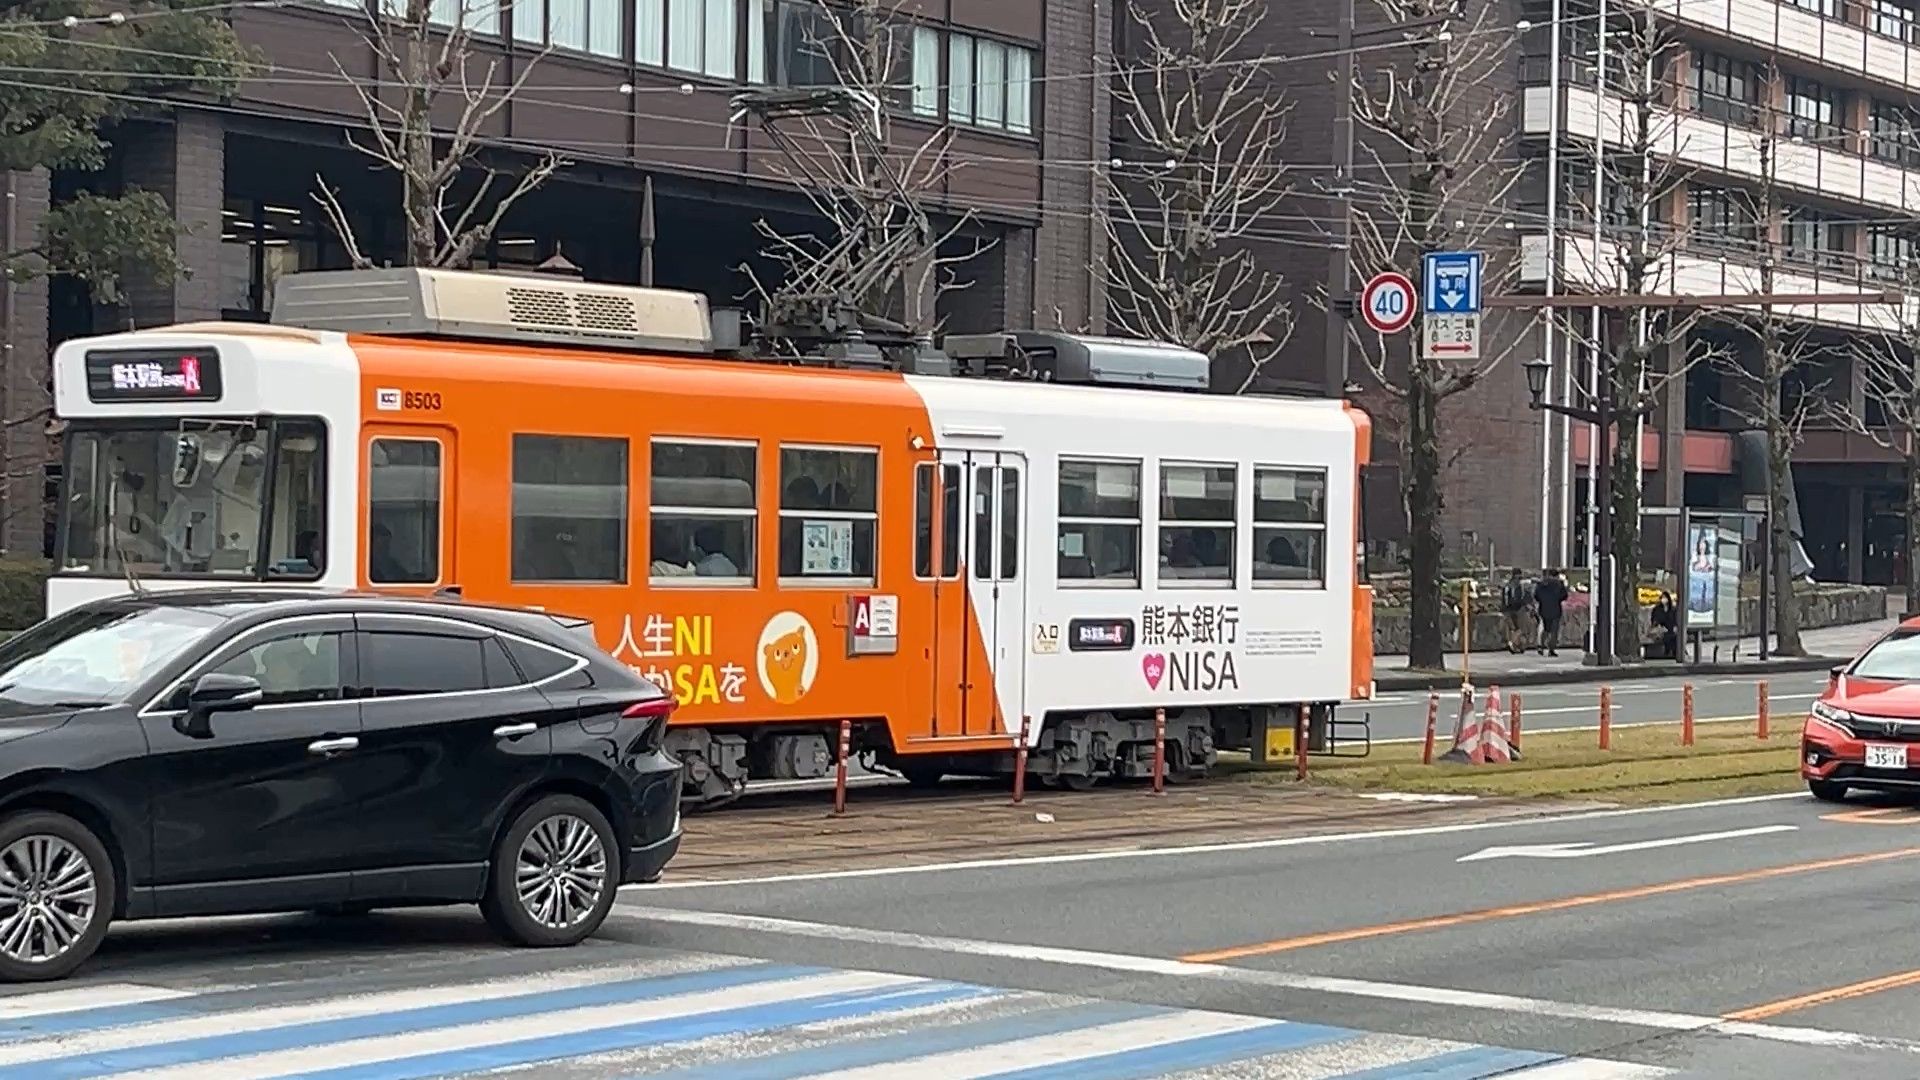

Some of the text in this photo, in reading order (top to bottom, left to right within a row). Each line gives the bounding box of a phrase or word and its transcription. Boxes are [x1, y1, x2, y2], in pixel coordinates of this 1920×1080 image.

[1375, 290, 1403, 315] 40
[405, 391, 441, 410] 8503
[855, 602, 870, 629] A
[1142, 605, 1239, 645] 熊本銀行
[611, 613, 712, 658] 人生NI
[1037, 624, 1058, 639] 入口
[1169, 651, 1239, 691] NISA
